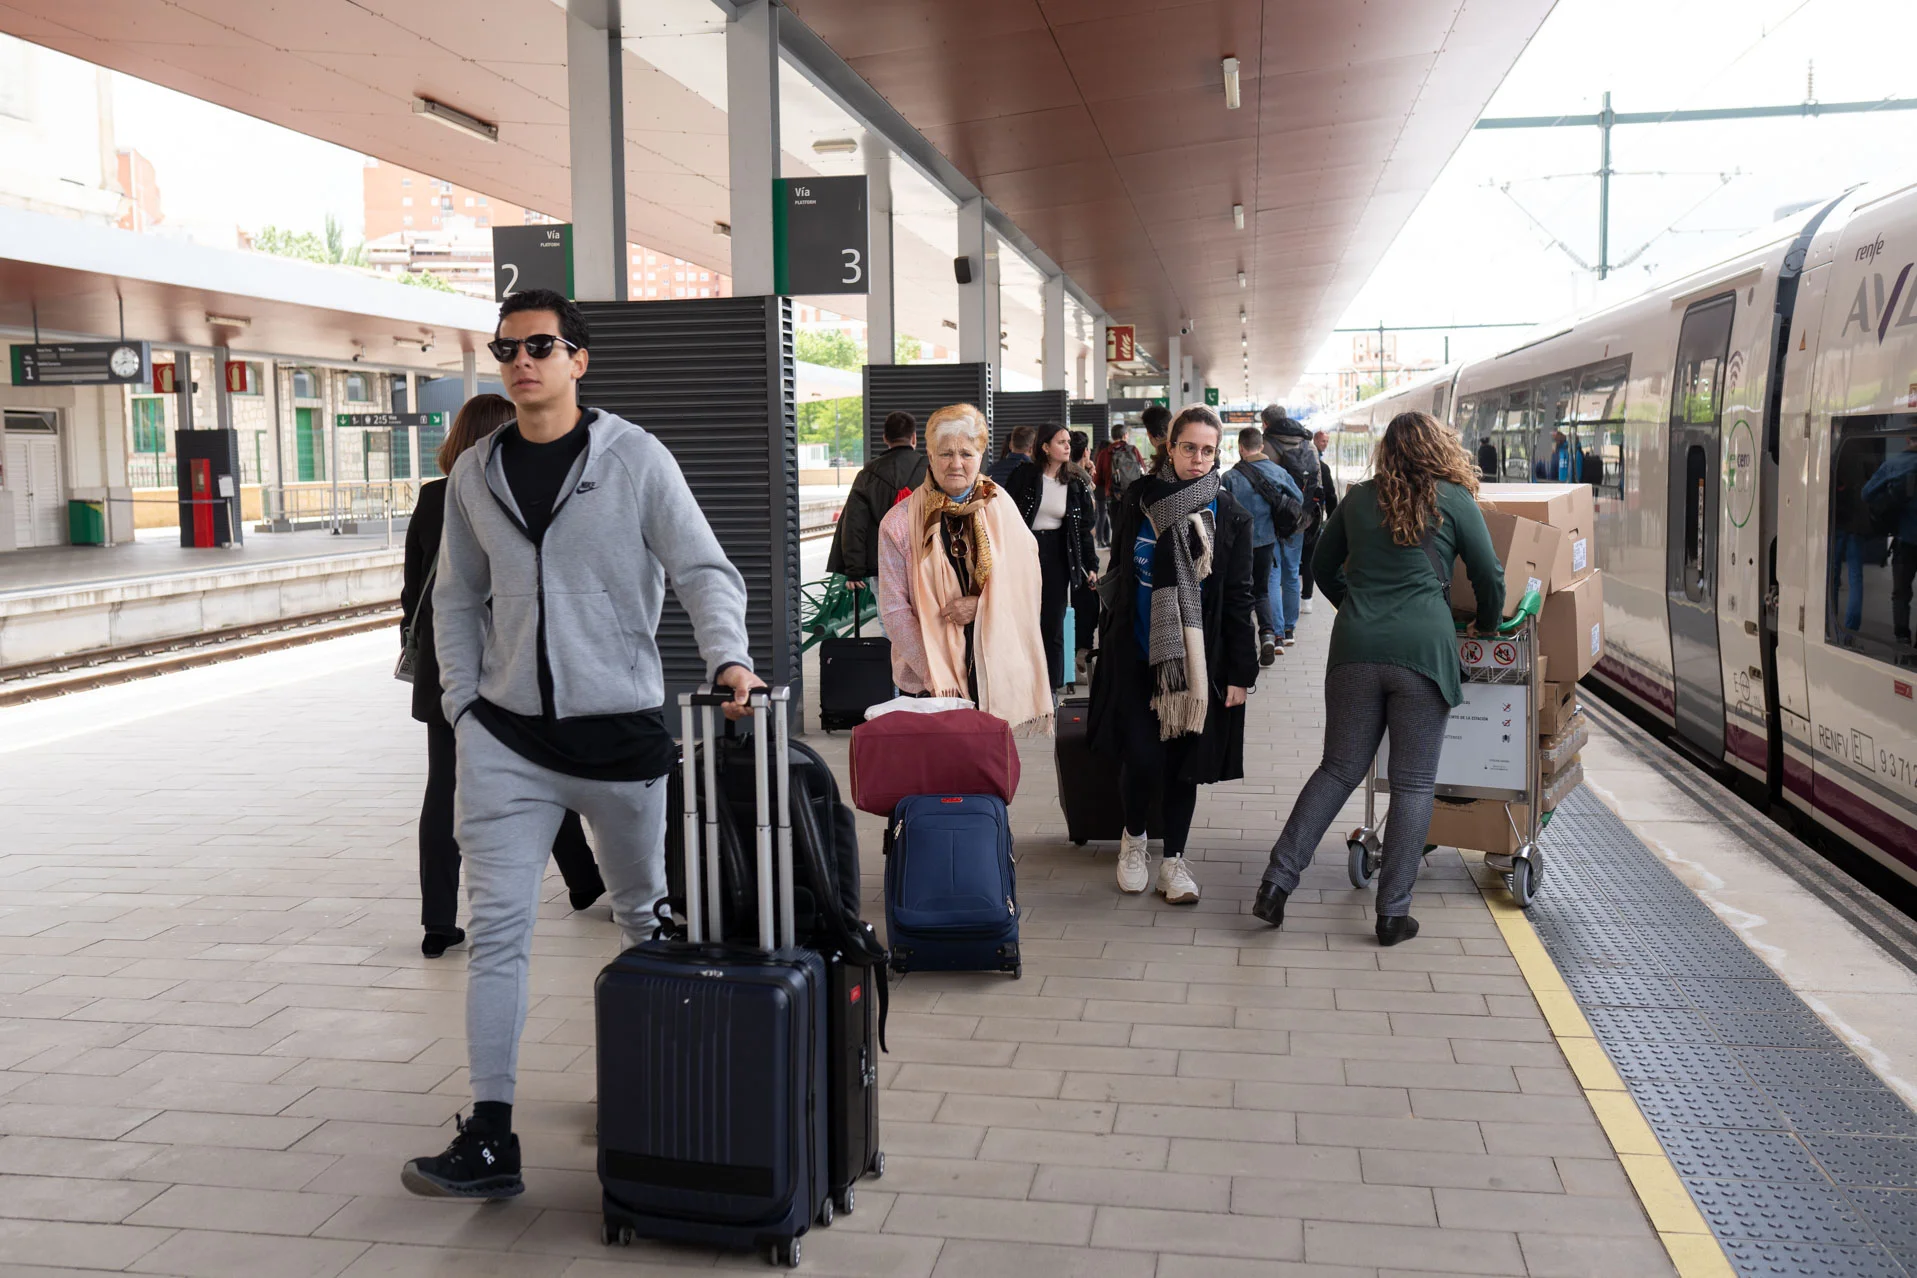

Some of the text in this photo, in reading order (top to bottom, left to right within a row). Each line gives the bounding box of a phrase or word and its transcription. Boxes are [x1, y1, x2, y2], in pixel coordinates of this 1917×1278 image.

[795, 187, 811, 197] Vía
[547, 230, 560, 240] Vía
[1854, 231, 1884, 265] renfe
[841, 248, 862, 284] 3
[501, 263, 519, 299] 2
[26, 366, 34, 380] 1
